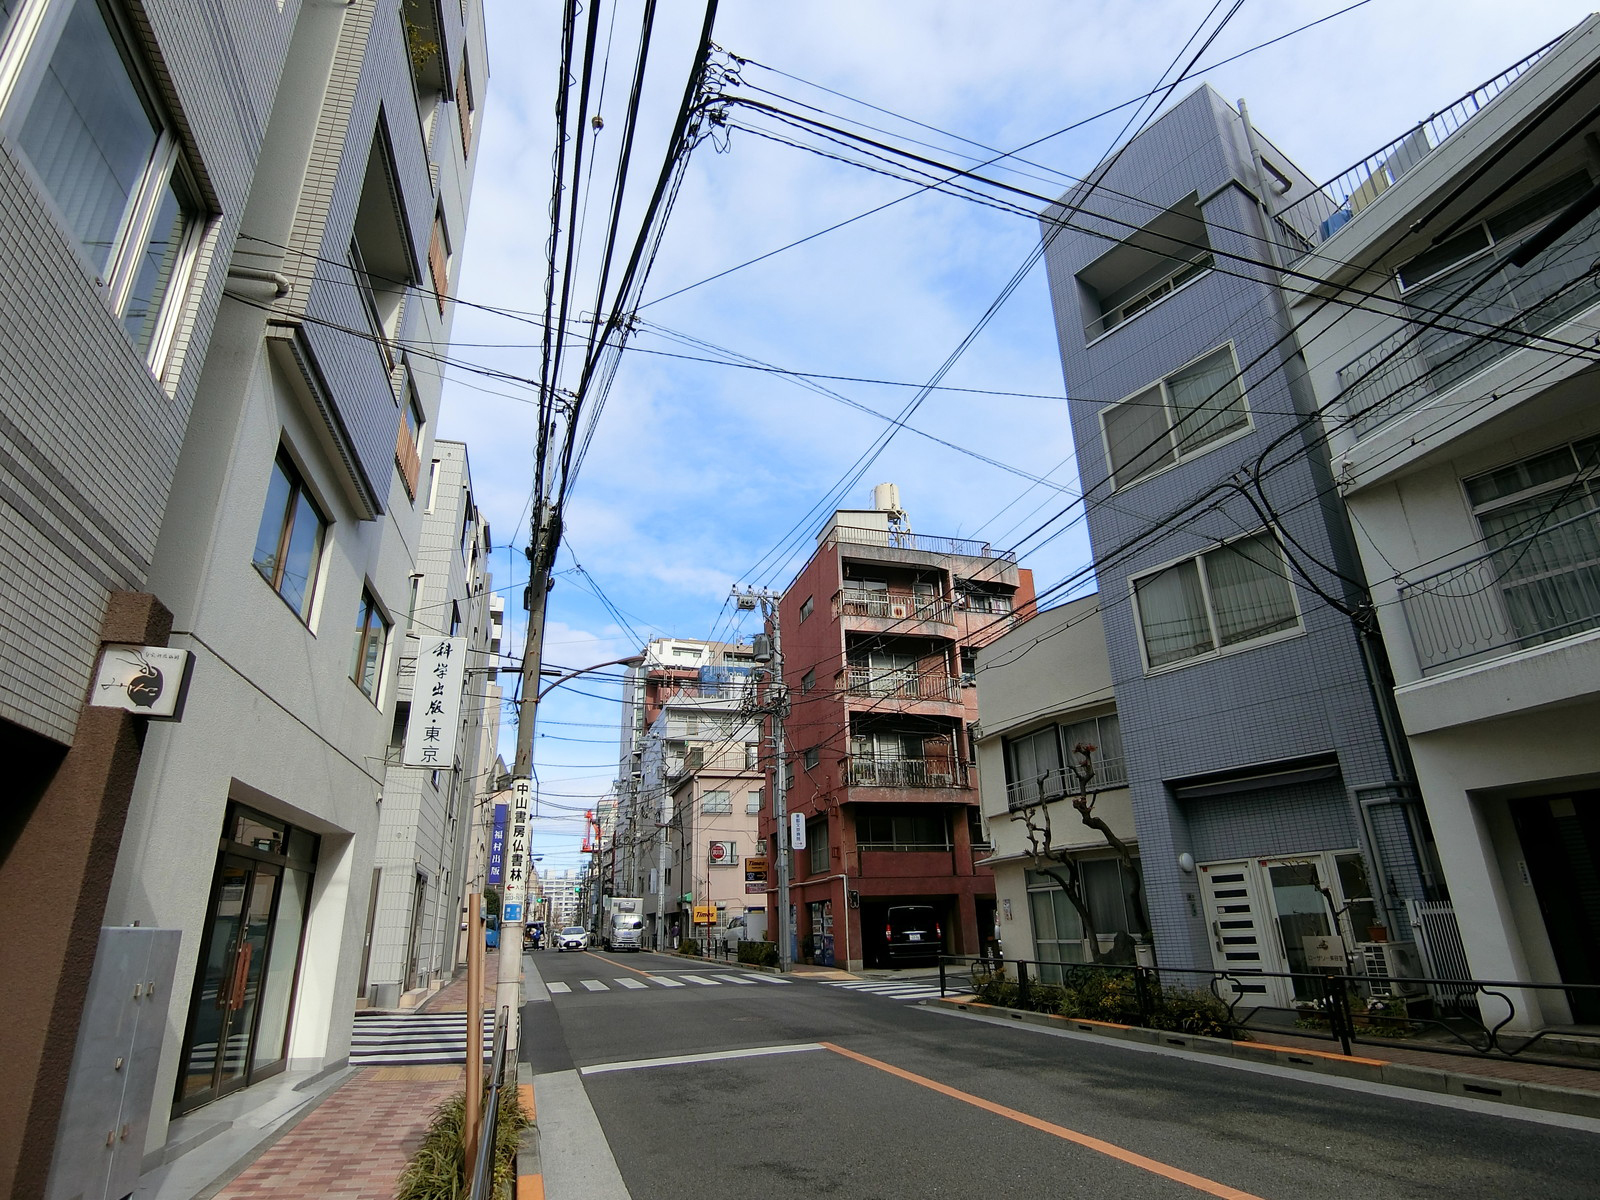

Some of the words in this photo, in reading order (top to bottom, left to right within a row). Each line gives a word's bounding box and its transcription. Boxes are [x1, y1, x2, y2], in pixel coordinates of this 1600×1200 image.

[421, 642, 453, 763] 科学出版・東京
[490, 830, 503, 876] 福村出版
[510, 782, 528, 881] 中山書房仏書林
